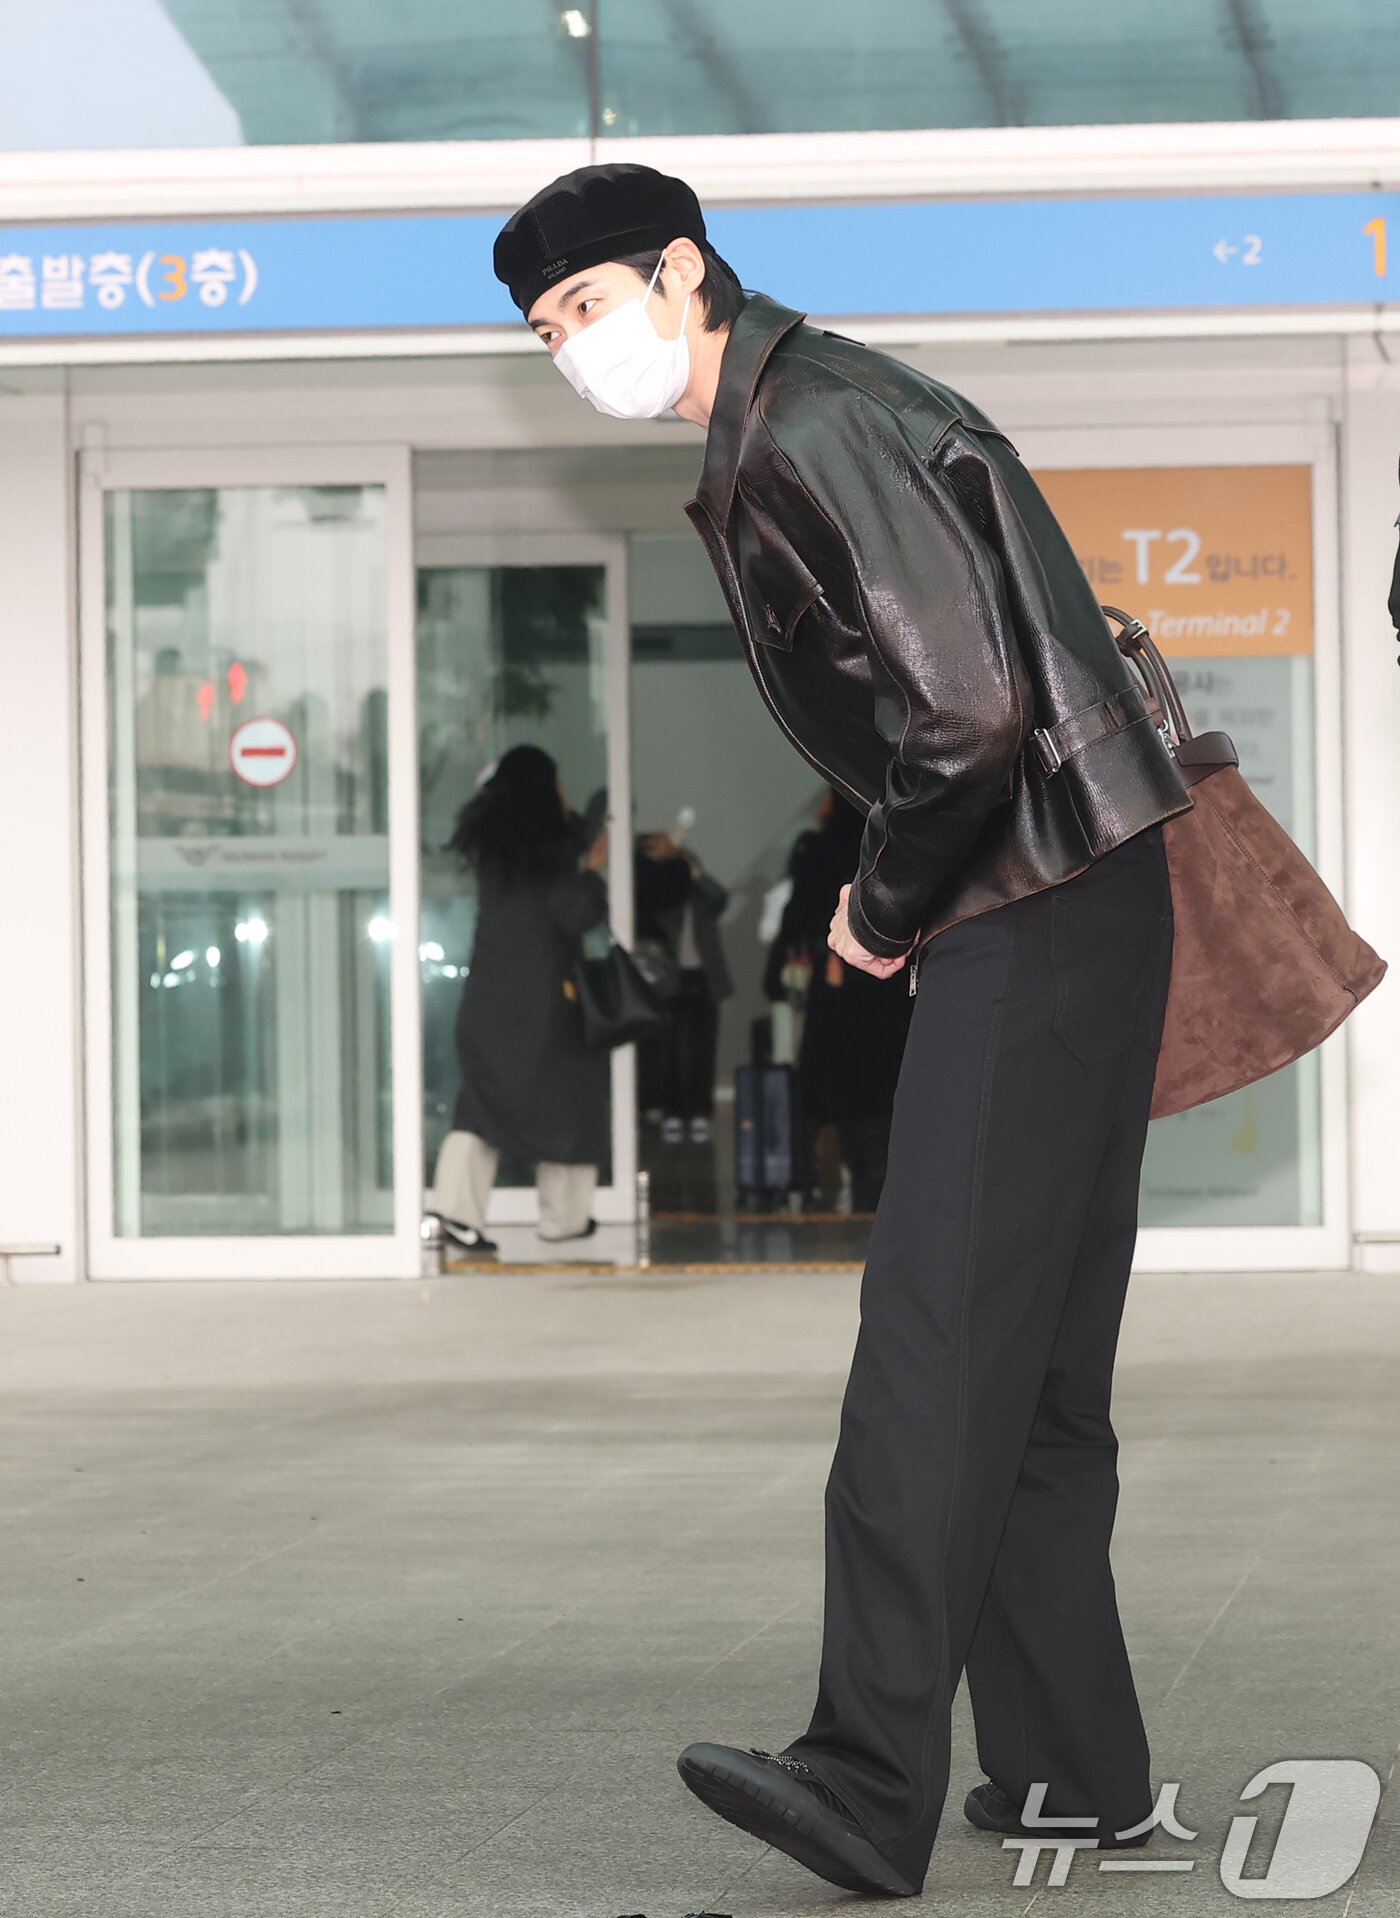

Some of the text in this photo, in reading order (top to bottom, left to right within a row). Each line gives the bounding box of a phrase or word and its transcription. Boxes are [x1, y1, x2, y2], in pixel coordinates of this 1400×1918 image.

[1241, 234, 1263, 266] 2
[1363, 217, 1387, 277] 1
[0, 249, 258, 309] 출발층(3층)
[542, 258, 568, 275] PRADA
[1148, 608, 1291, 638] Terminal 2
